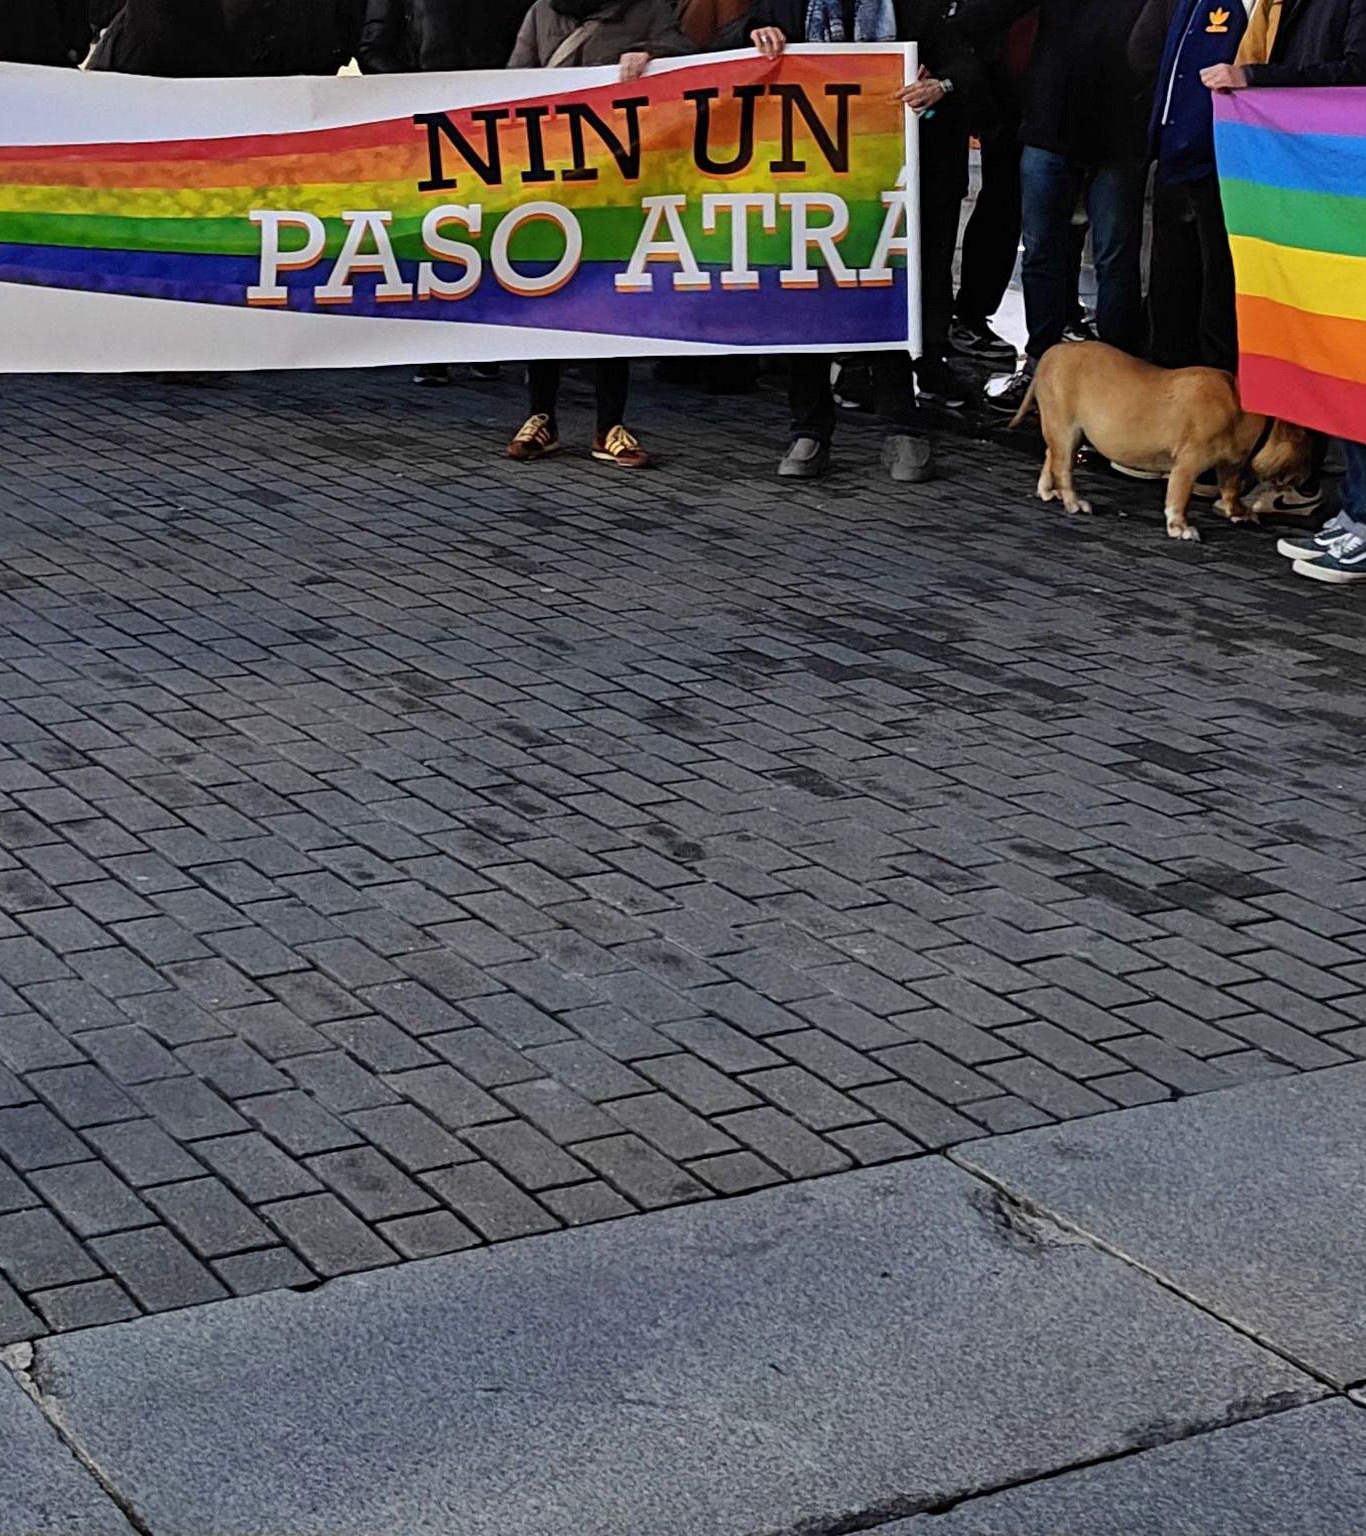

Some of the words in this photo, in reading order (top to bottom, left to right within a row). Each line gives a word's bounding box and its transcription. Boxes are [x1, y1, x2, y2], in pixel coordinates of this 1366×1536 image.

[412, 95, 649, 194] NIN
[682, 83, 861, 177] UN
[245, 200, 584, 306] PASO
